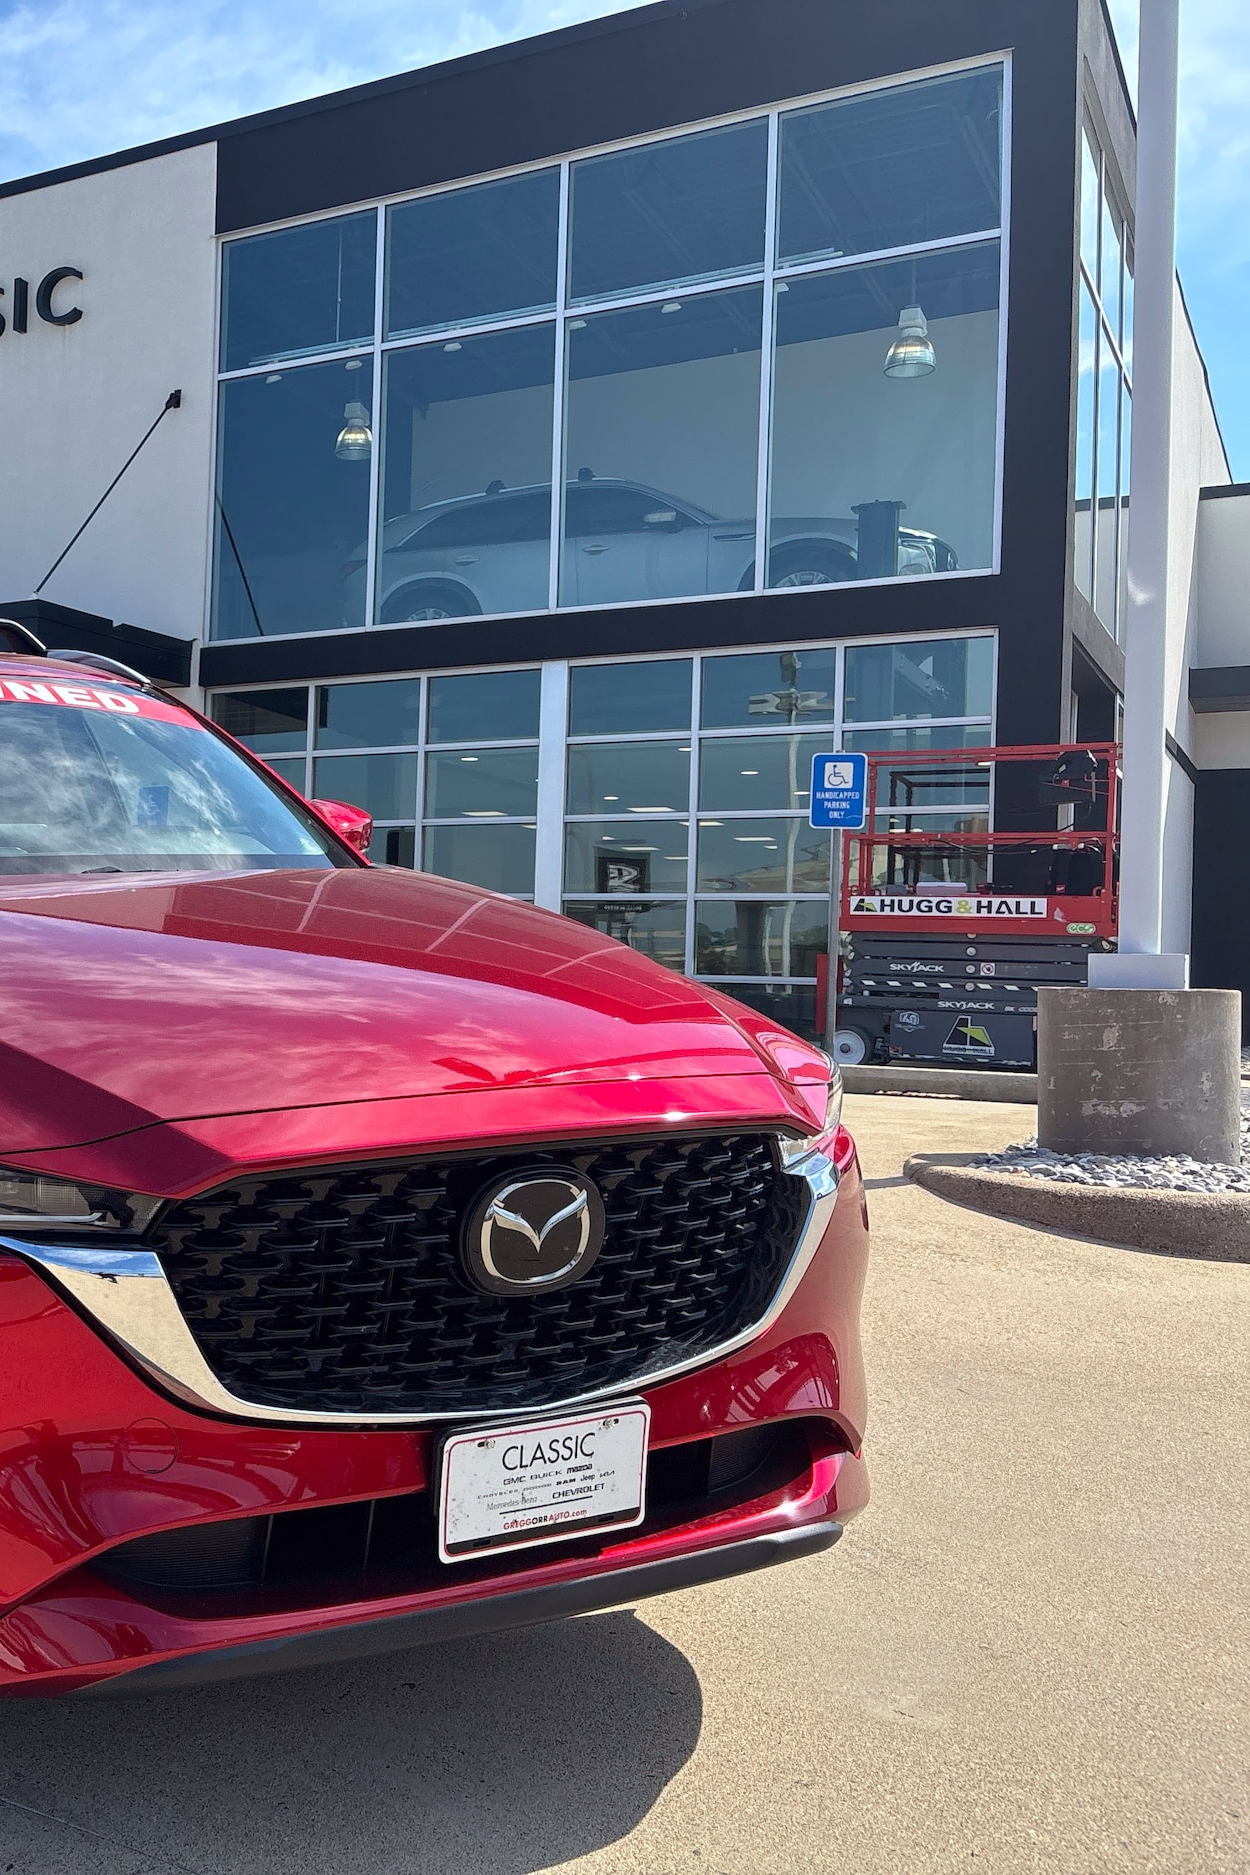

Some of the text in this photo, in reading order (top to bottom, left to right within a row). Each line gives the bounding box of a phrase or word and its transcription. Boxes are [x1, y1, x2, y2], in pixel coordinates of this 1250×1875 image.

[816, 791, 860, 800] HANDICAPPED
[823, 801, 851, 809] PARKING
[828, 810, 846, 819] ONLY
[889, 961, 945, 973] SKYJACK
[937, 1000, 996, 1010] SKYJACK
[502, 1432, 596, 1471] CLASSIC
[503, 1475, 527, 1486] GMC
[530, 1469, 563, 1480] BUICK
[556, 1478, 577, 1486] RAM
[580, 1474, 596, 1483] Jeep
[486, 1482, 606, 1511] Mercedes-Benz CHEVROLET
[503, 1509, 588, 1530] GREGGORRAUTO.com
